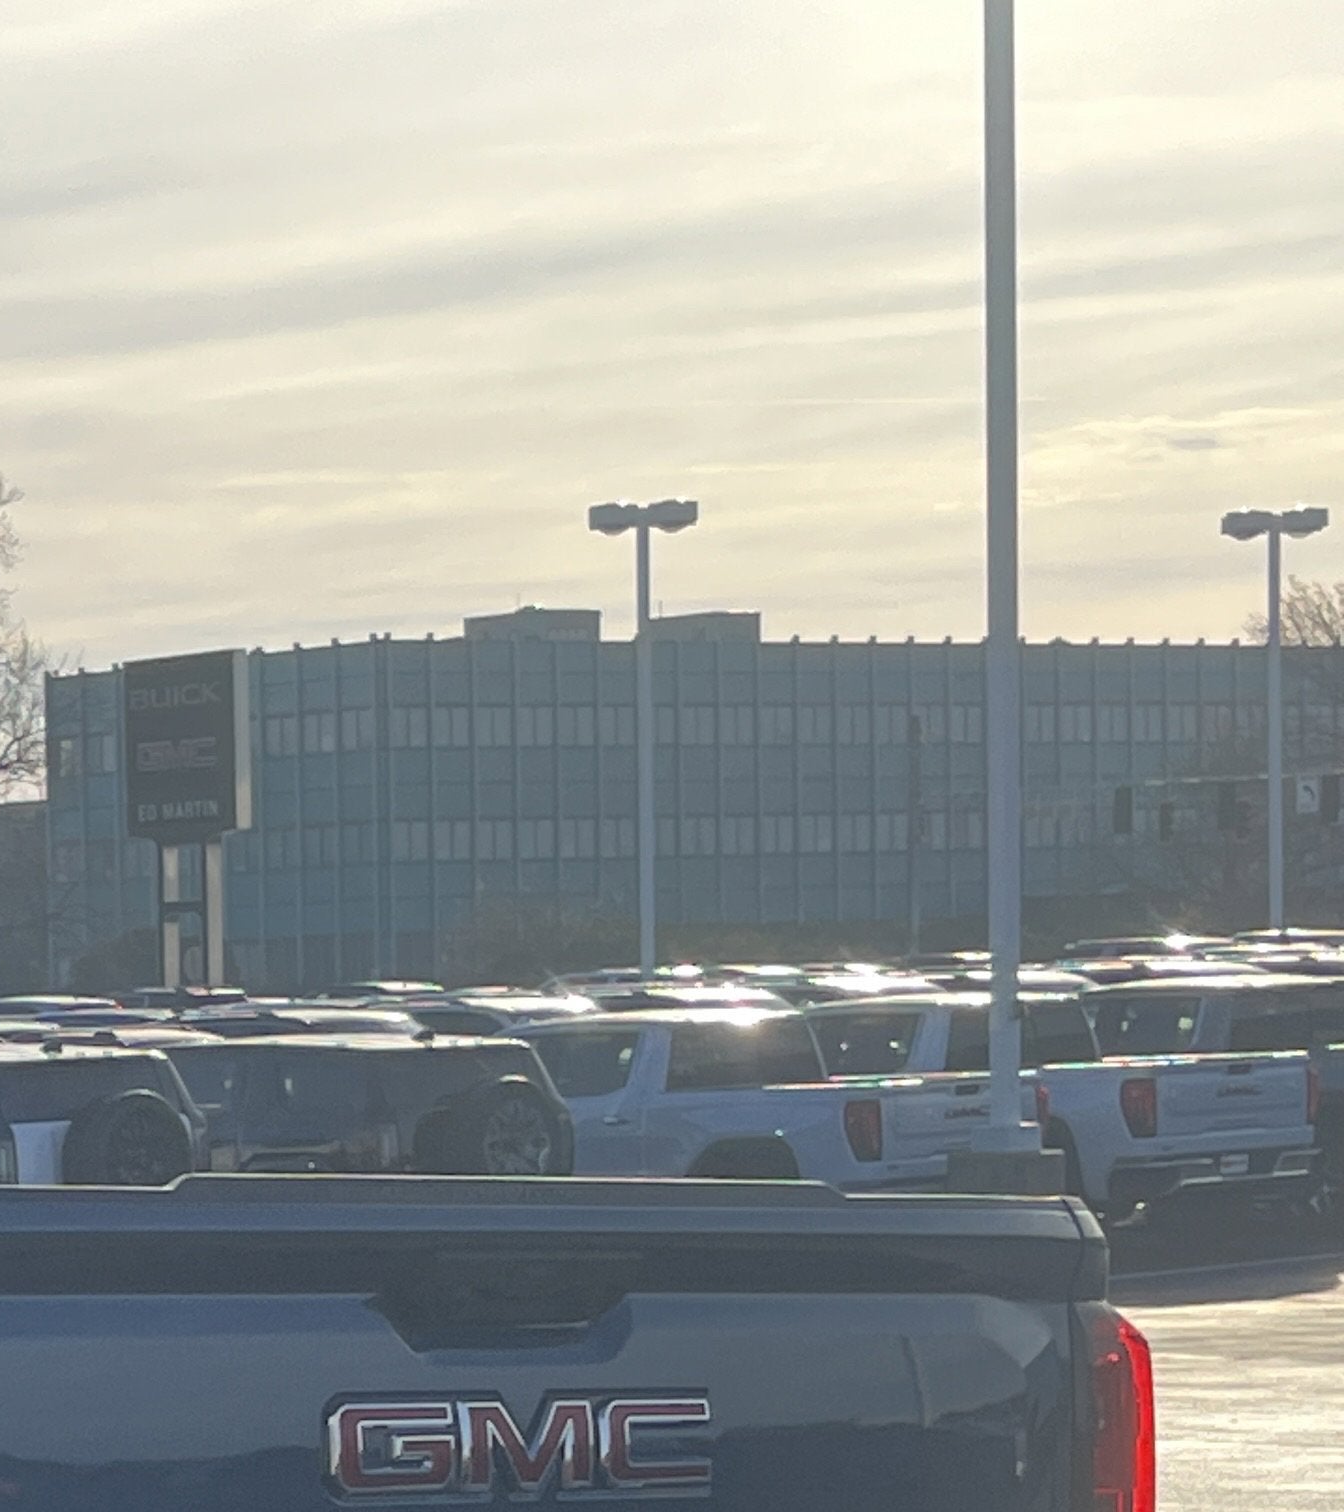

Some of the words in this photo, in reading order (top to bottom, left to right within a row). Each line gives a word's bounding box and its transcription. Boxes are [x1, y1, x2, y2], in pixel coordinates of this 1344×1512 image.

[128, 681, 222, 710] BUICK
[136, 736, 217, 772] GMC
[138, 804, 158, 822] ED
[162, 800, 219, 820] MARTIN
[324, 1389, 712, 1505] GMC
